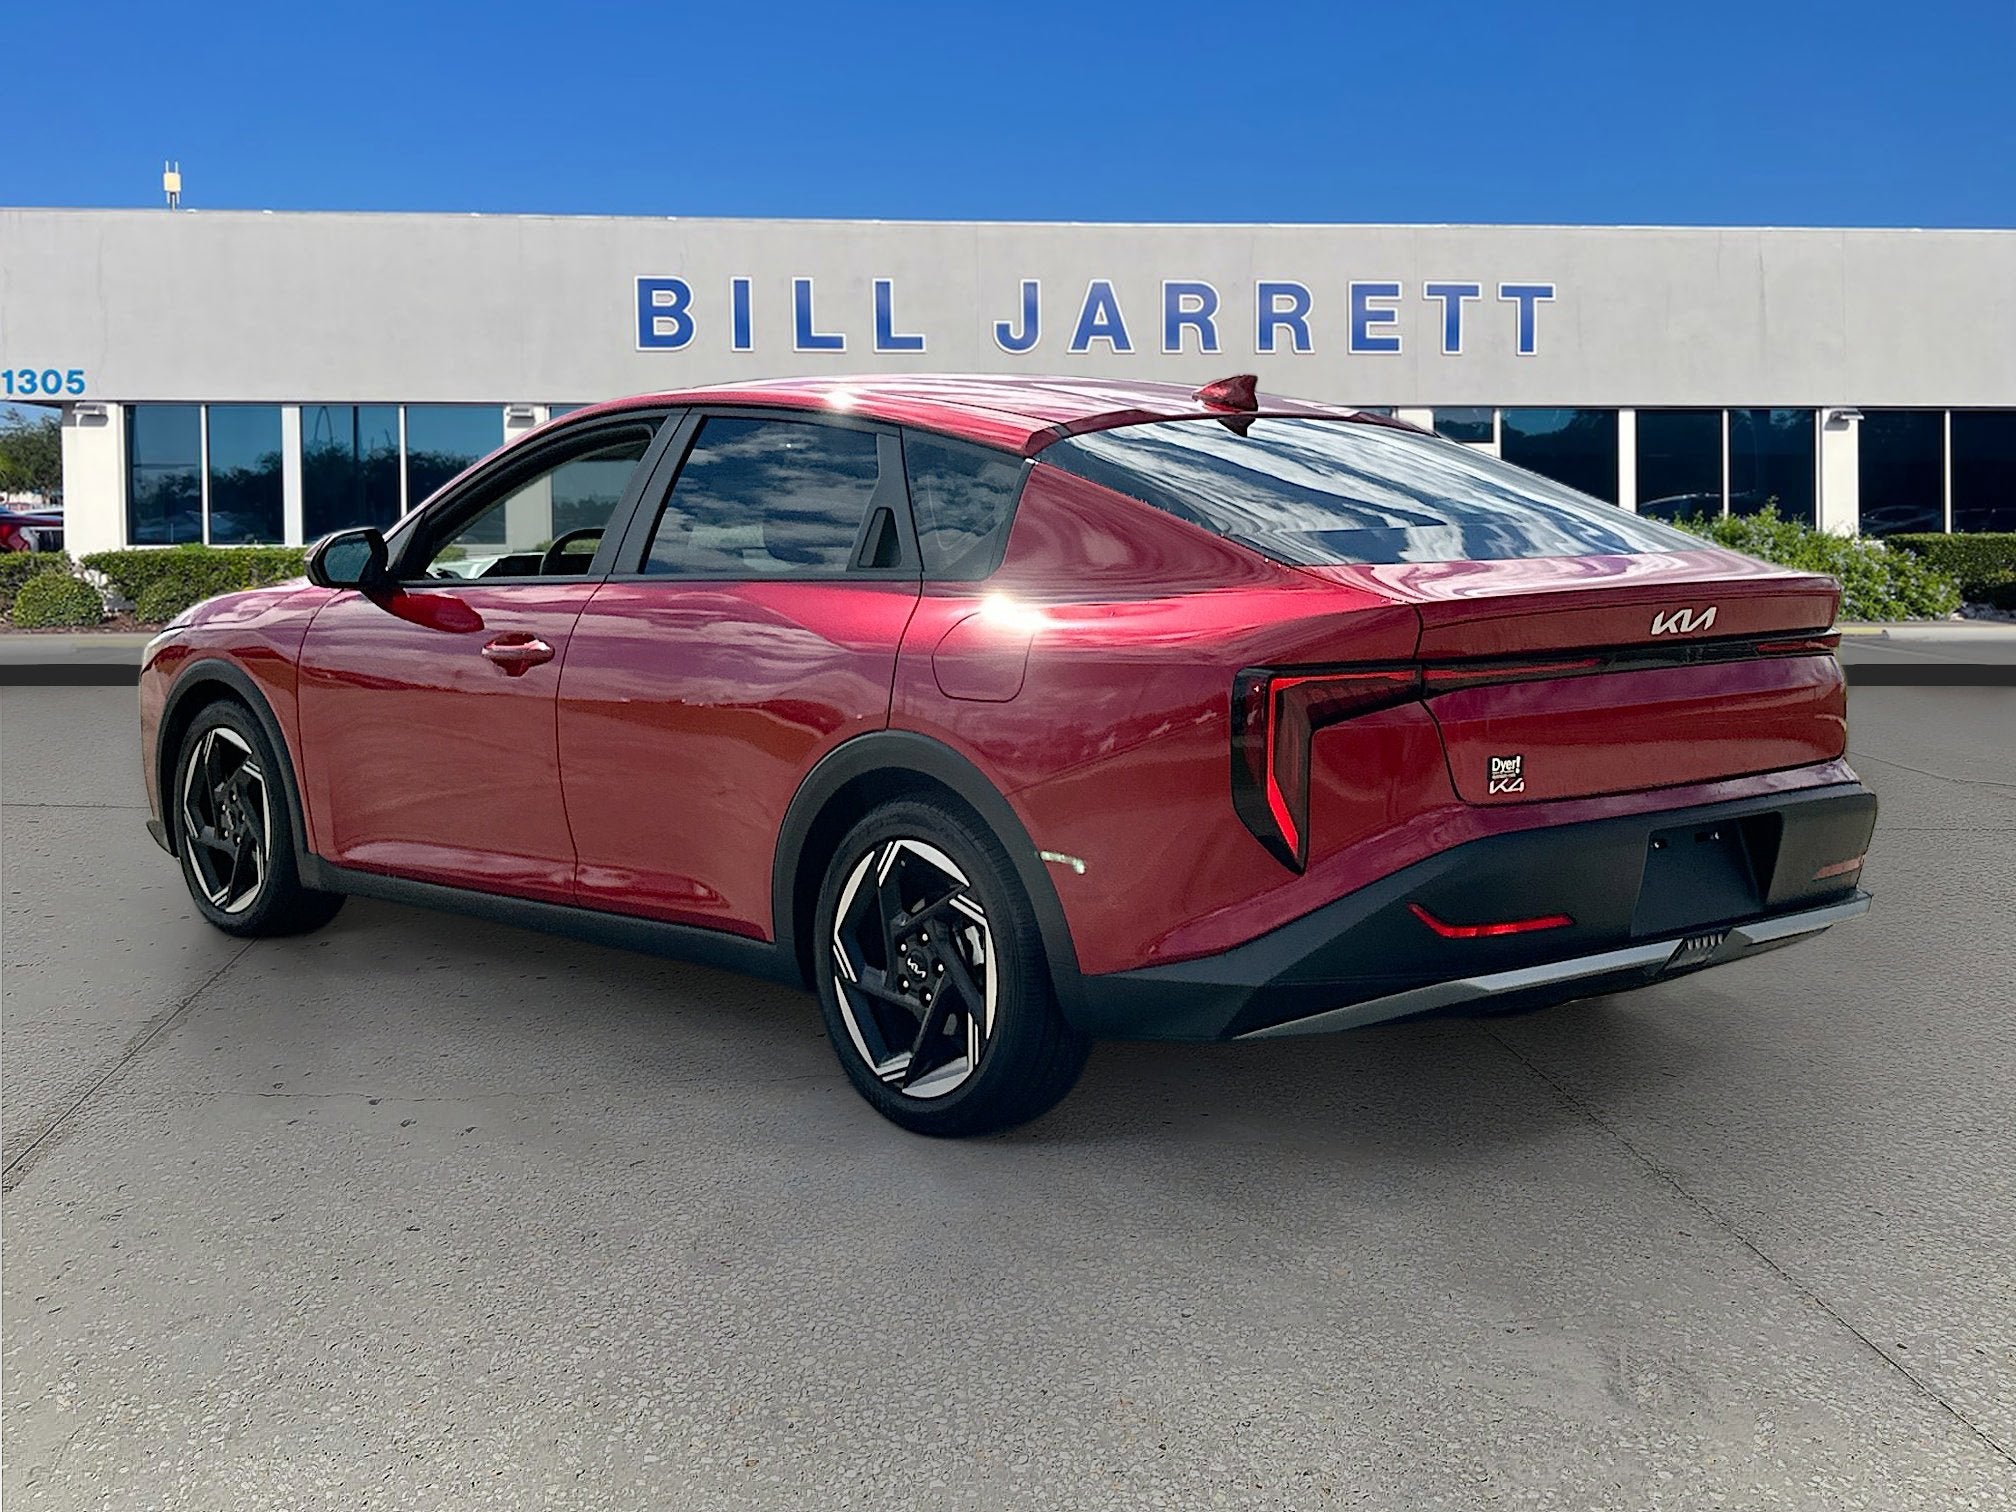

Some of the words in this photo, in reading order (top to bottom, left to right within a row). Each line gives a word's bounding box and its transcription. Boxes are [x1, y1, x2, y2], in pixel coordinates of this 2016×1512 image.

[634, 275, 926, 353] BILL
[993, 279, 1556, 355] JARRETT
[1, 368, 86, 395] 1305
[1650, 606, 1718, 636] KIA
[1489, 777, 1525, 795] K4
